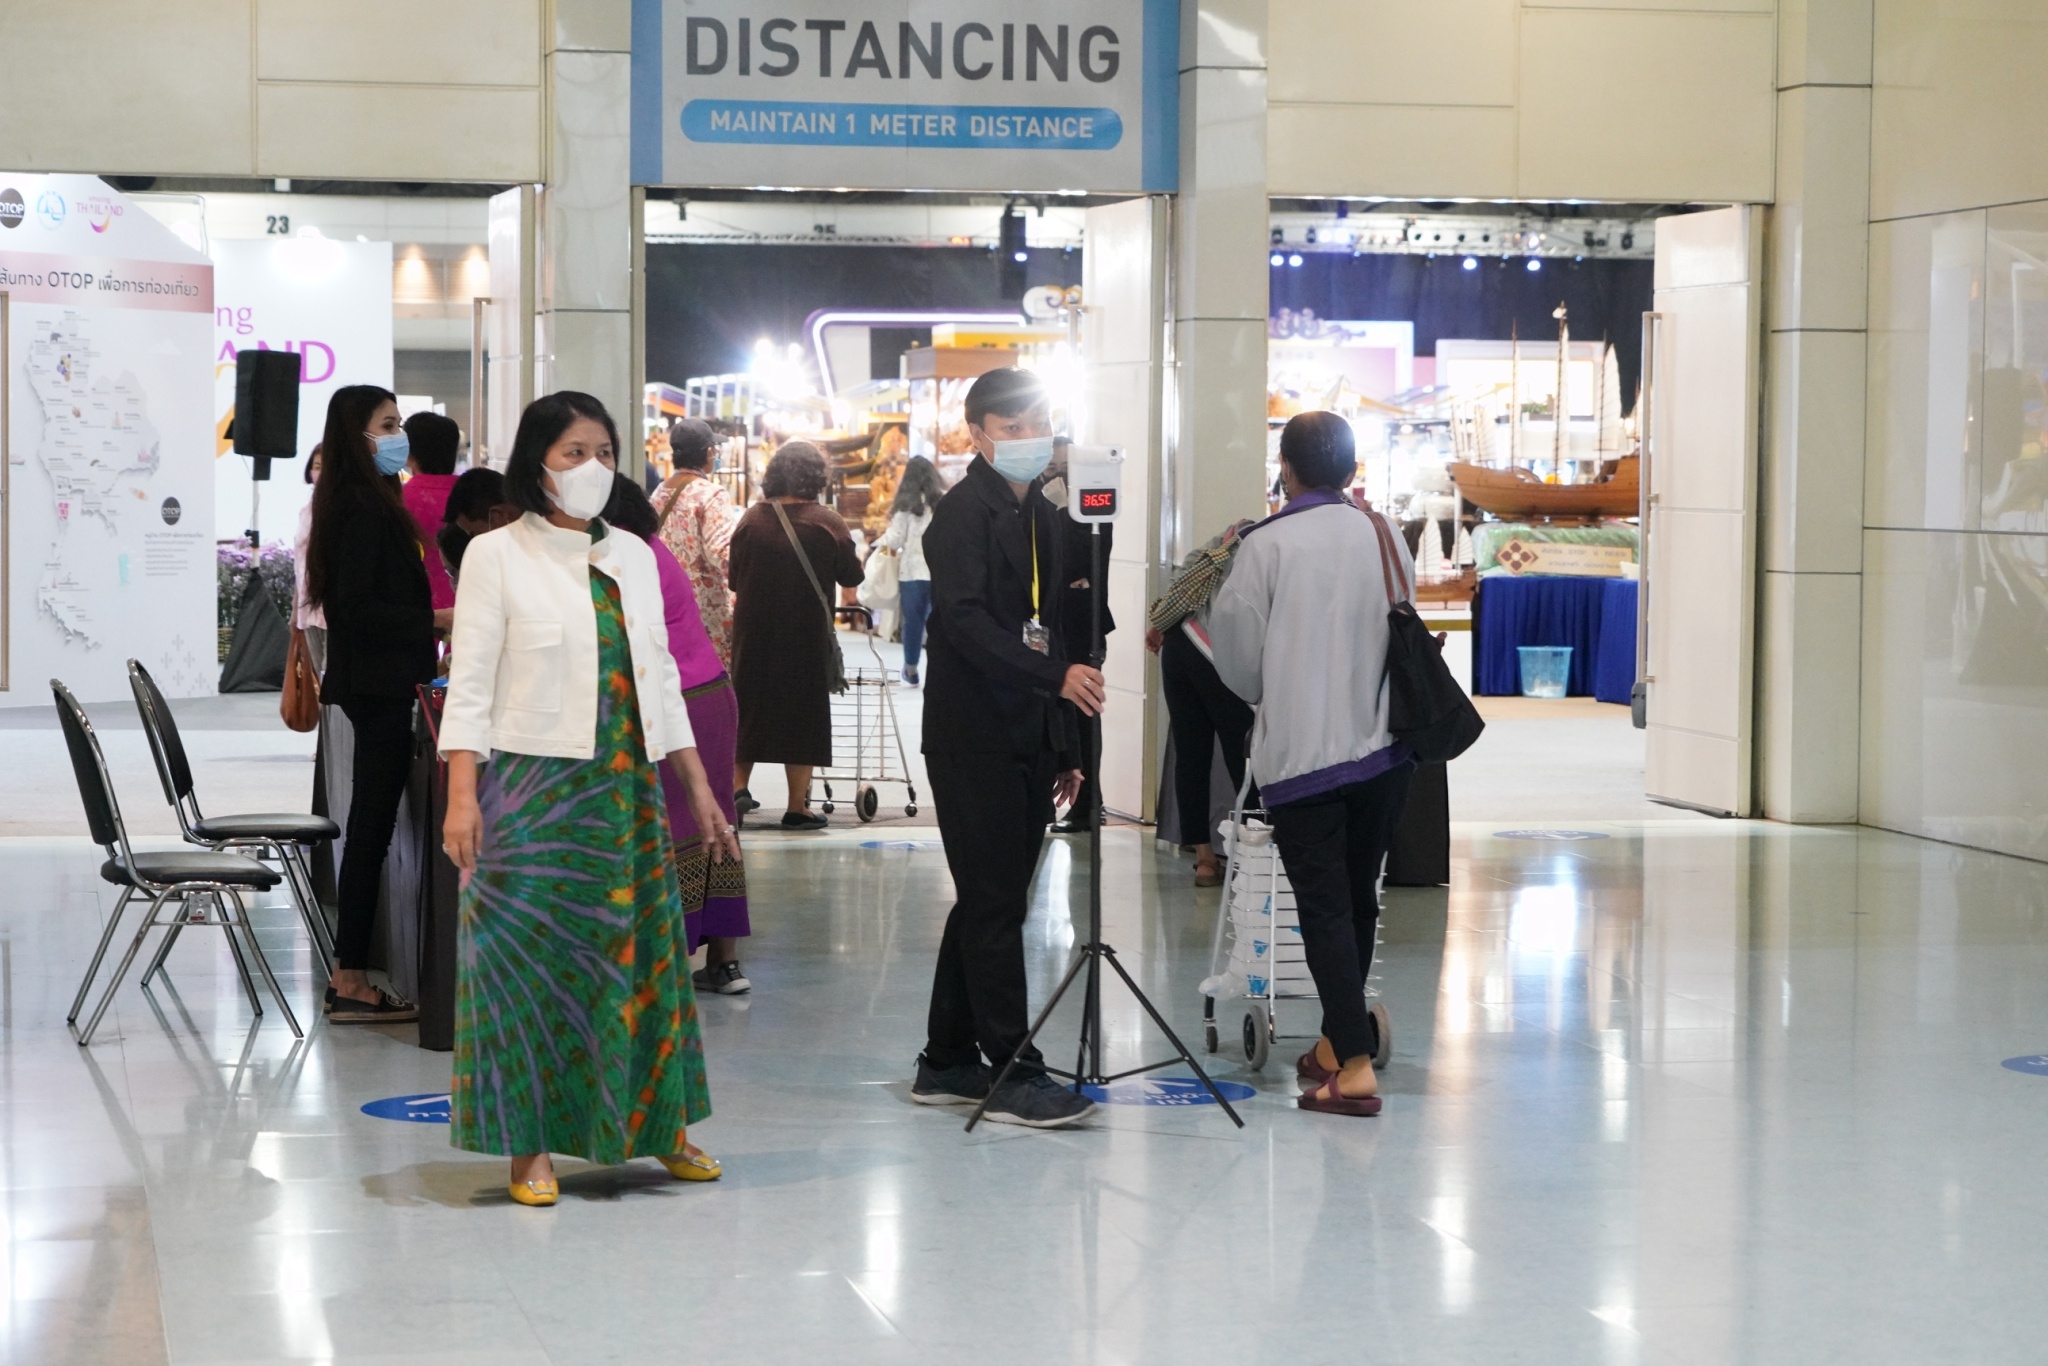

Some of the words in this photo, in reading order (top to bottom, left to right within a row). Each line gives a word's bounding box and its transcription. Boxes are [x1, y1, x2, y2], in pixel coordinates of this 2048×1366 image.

[686, 17, 1120, 83] DISTANCING
[710, 110, 836, 134] MAINTAIN
[845, 114, 856, 134] 1
[870, 114, 957, 136] METER
[970, 116, 1094, 138] DISTANCE
[0, 202, 24, 214] OTOP
[76, 202, 123, 216] THAILAND
[266, 215, 289, 234] 23
[0, 267, 42, 286] ส้นทาง
[48, 271, 93, 290] OTOP
[98, 270, 199, 296] เพื่อการท่องเที่ยว
